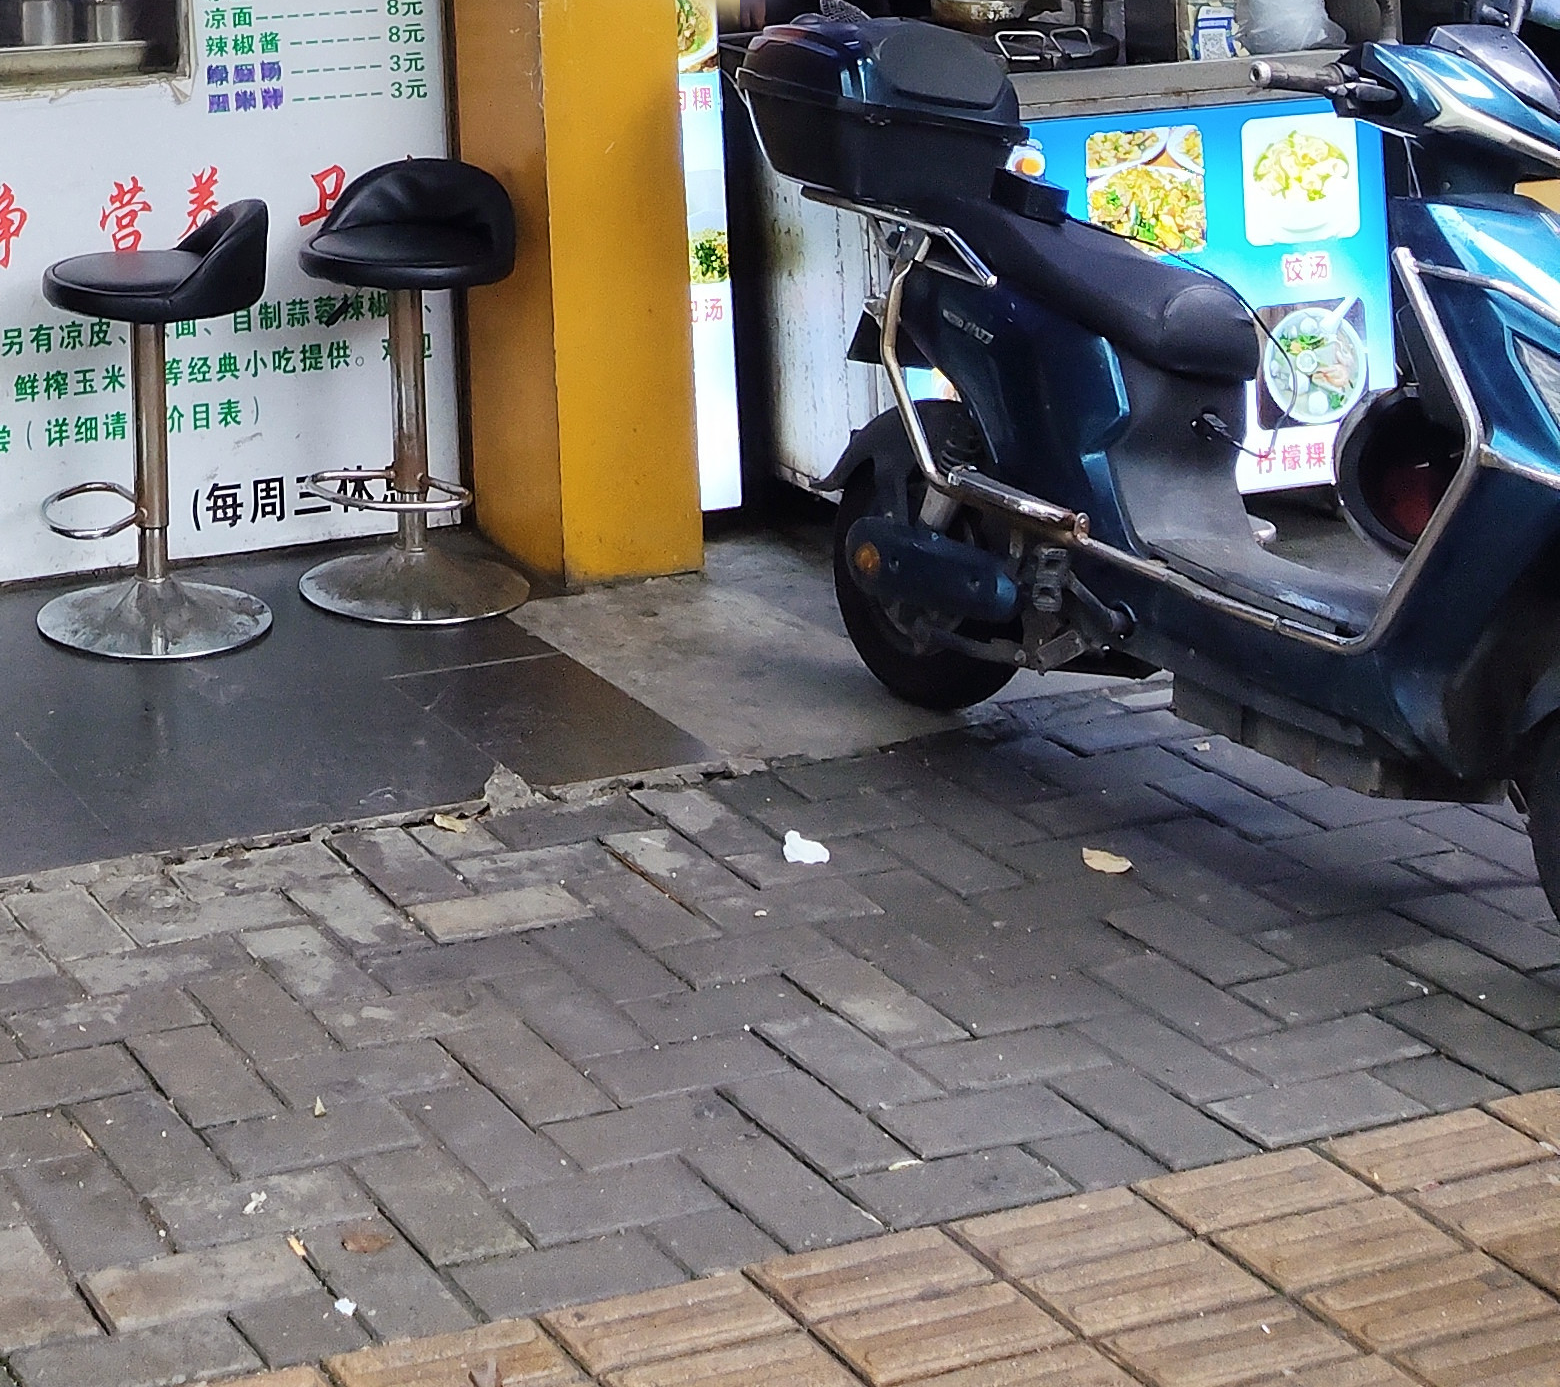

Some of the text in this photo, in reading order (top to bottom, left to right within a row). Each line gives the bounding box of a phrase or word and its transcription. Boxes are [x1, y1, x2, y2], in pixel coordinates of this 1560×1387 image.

[204, 5, 253, 29] 凉面
[205, 23, 426, 58] 辣椒酱 8元
[389, 51, 426, 73] 3元
[390, 78, 428, 100] 3元
[1283, 254, 1329, 283] 饺汤
